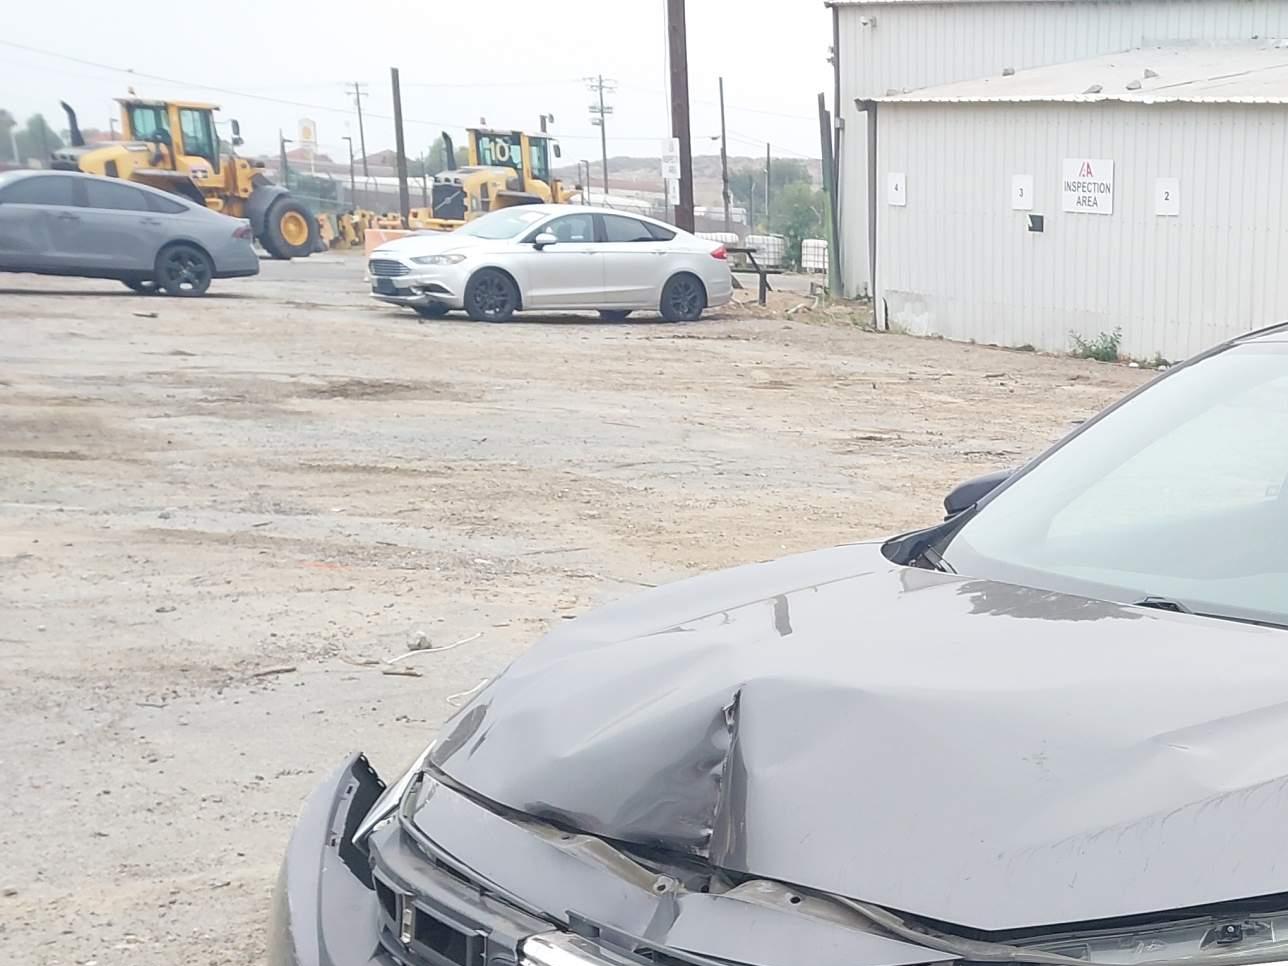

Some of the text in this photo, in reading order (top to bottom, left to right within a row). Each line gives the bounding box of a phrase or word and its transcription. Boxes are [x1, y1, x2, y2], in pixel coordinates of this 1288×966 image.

[1018, 188, 1024, 198] 3
[1064, 181, 1111, 195] INSPECTION
[1164, 191, 1170, 201] 2
[1076, 196, 1098, 208] AREA
